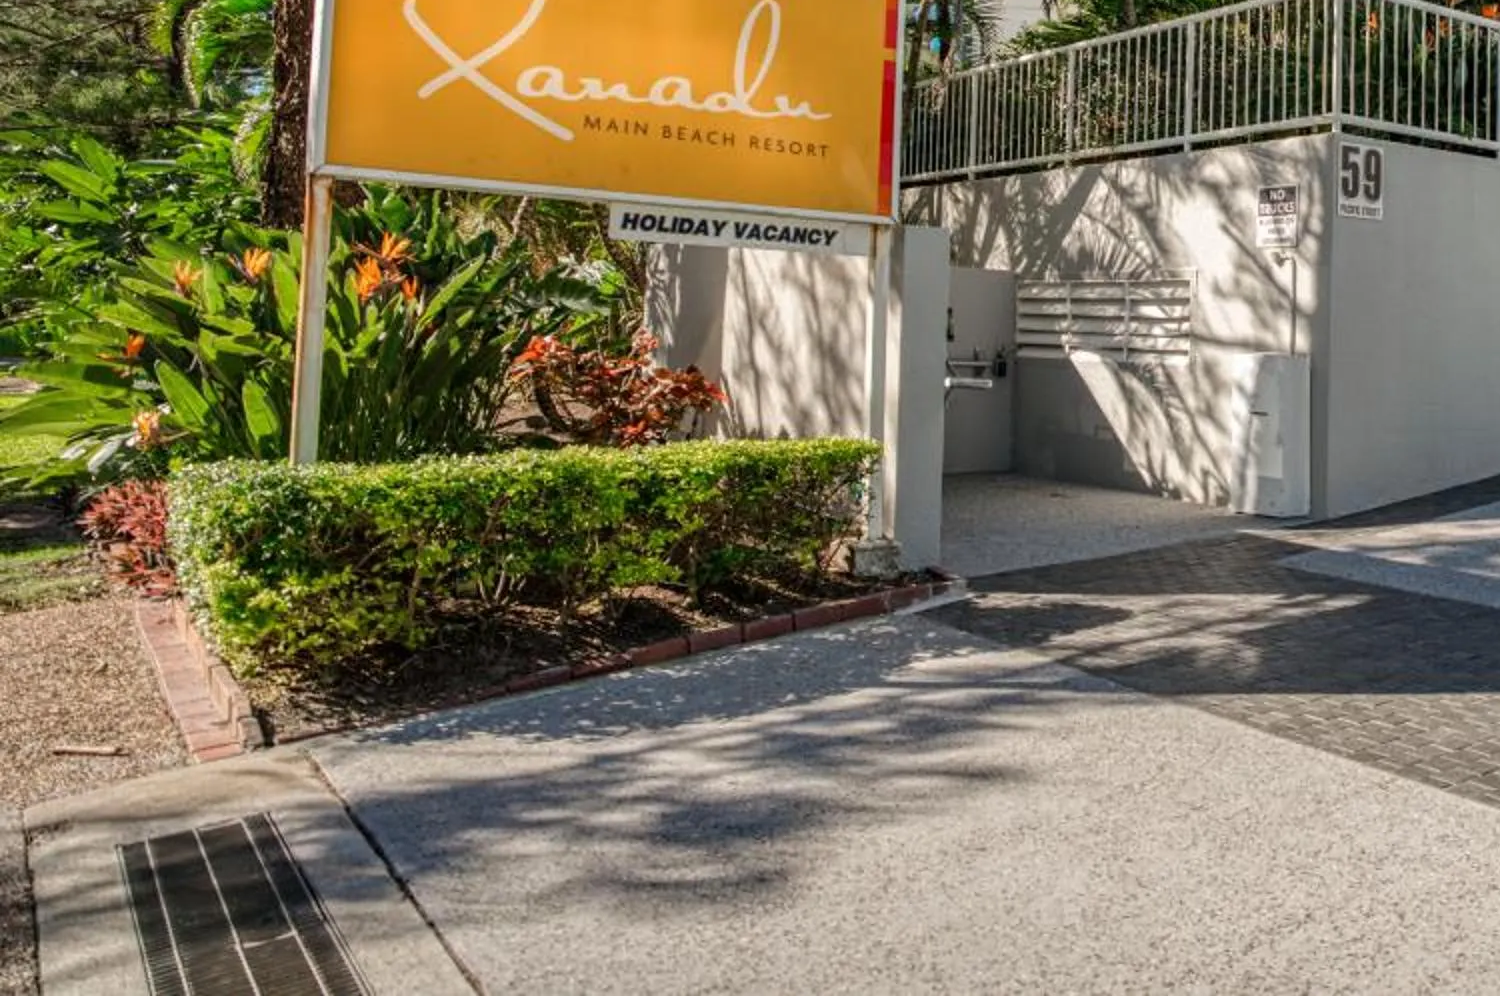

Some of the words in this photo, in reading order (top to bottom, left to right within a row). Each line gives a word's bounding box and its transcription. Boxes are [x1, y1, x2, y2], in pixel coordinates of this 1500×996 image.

[583, 115, 649, 136] MAIN
[661, 125, 736, 147] BEACH
[749, 136, 831, 157] RESORT
[1341, 145, 1381, 202] 59
[1269, 190, 1285, 201] NO
[620, 212, 729, 238] HOLIDAY
[733, 223, 839, 247] VACANCY
